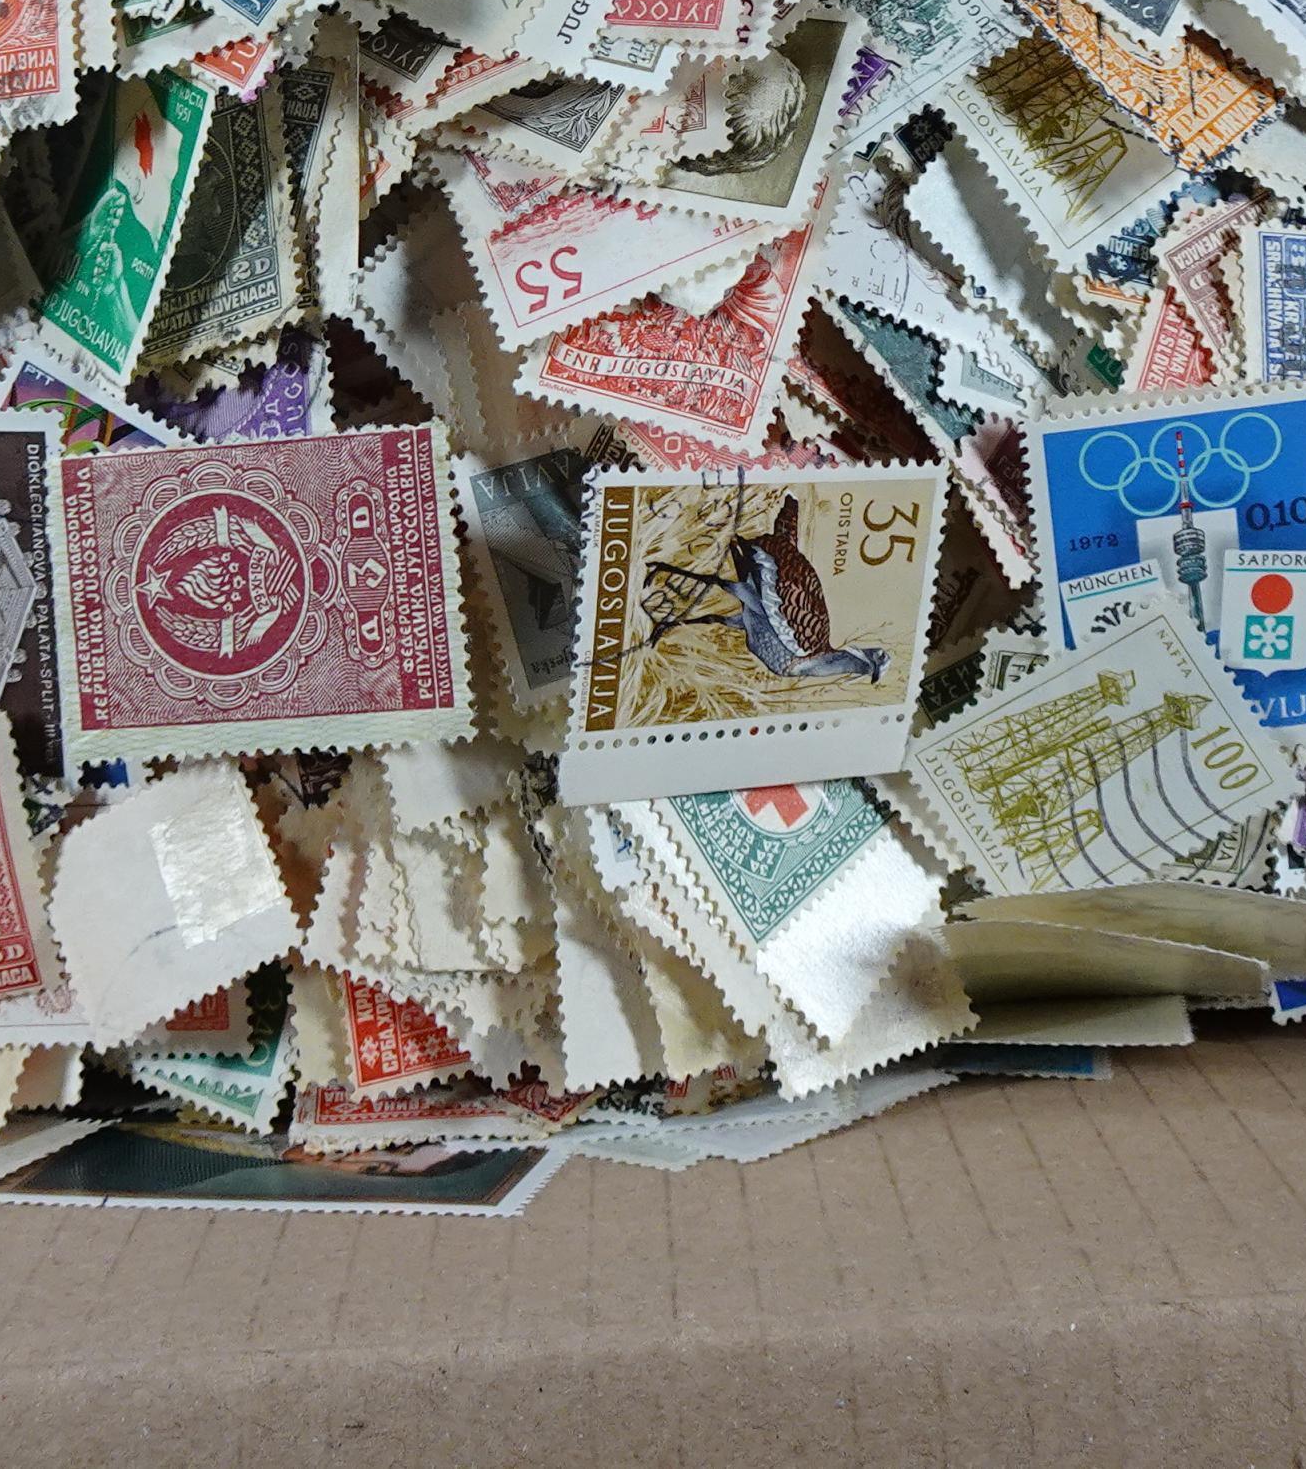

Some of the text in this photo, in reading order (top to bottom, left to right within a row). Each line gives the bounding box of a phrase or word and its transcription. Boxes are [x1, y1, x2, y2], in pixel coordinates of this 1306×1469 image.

[173, 102, 192, 122] 1951
[508, 240, 594, 317] 55
[49, 299, 134, 366] JUGOSLAVIJA
[22, 363, 56, 387] PTT
[560, 346, 750, 400] FNR JUGOSLAVIJA
[384, 434, 436, 578] ЈУГОСЛАВИЈА
[830, 491, 854, 576] OTIS TARDA
[857, 497, 919, 570] 35
[1068, 532, 1120, 553] 1972
[57, 492, 104, 694] FEDERATIVNA NARODNA
[62, 463, 118, 722] REPUBLIKA JUGOSLAVIJA
[581, 498, 628, 722] JUGOSLAVIJA
[1068, 562, 1154, 595] MÜNCHEN
[1155, 626, 1194, 680] NAFTA
[1186, 716, 1265, 798] 100
[921, 751, 1015, 875] JUGOSLAVIJA
